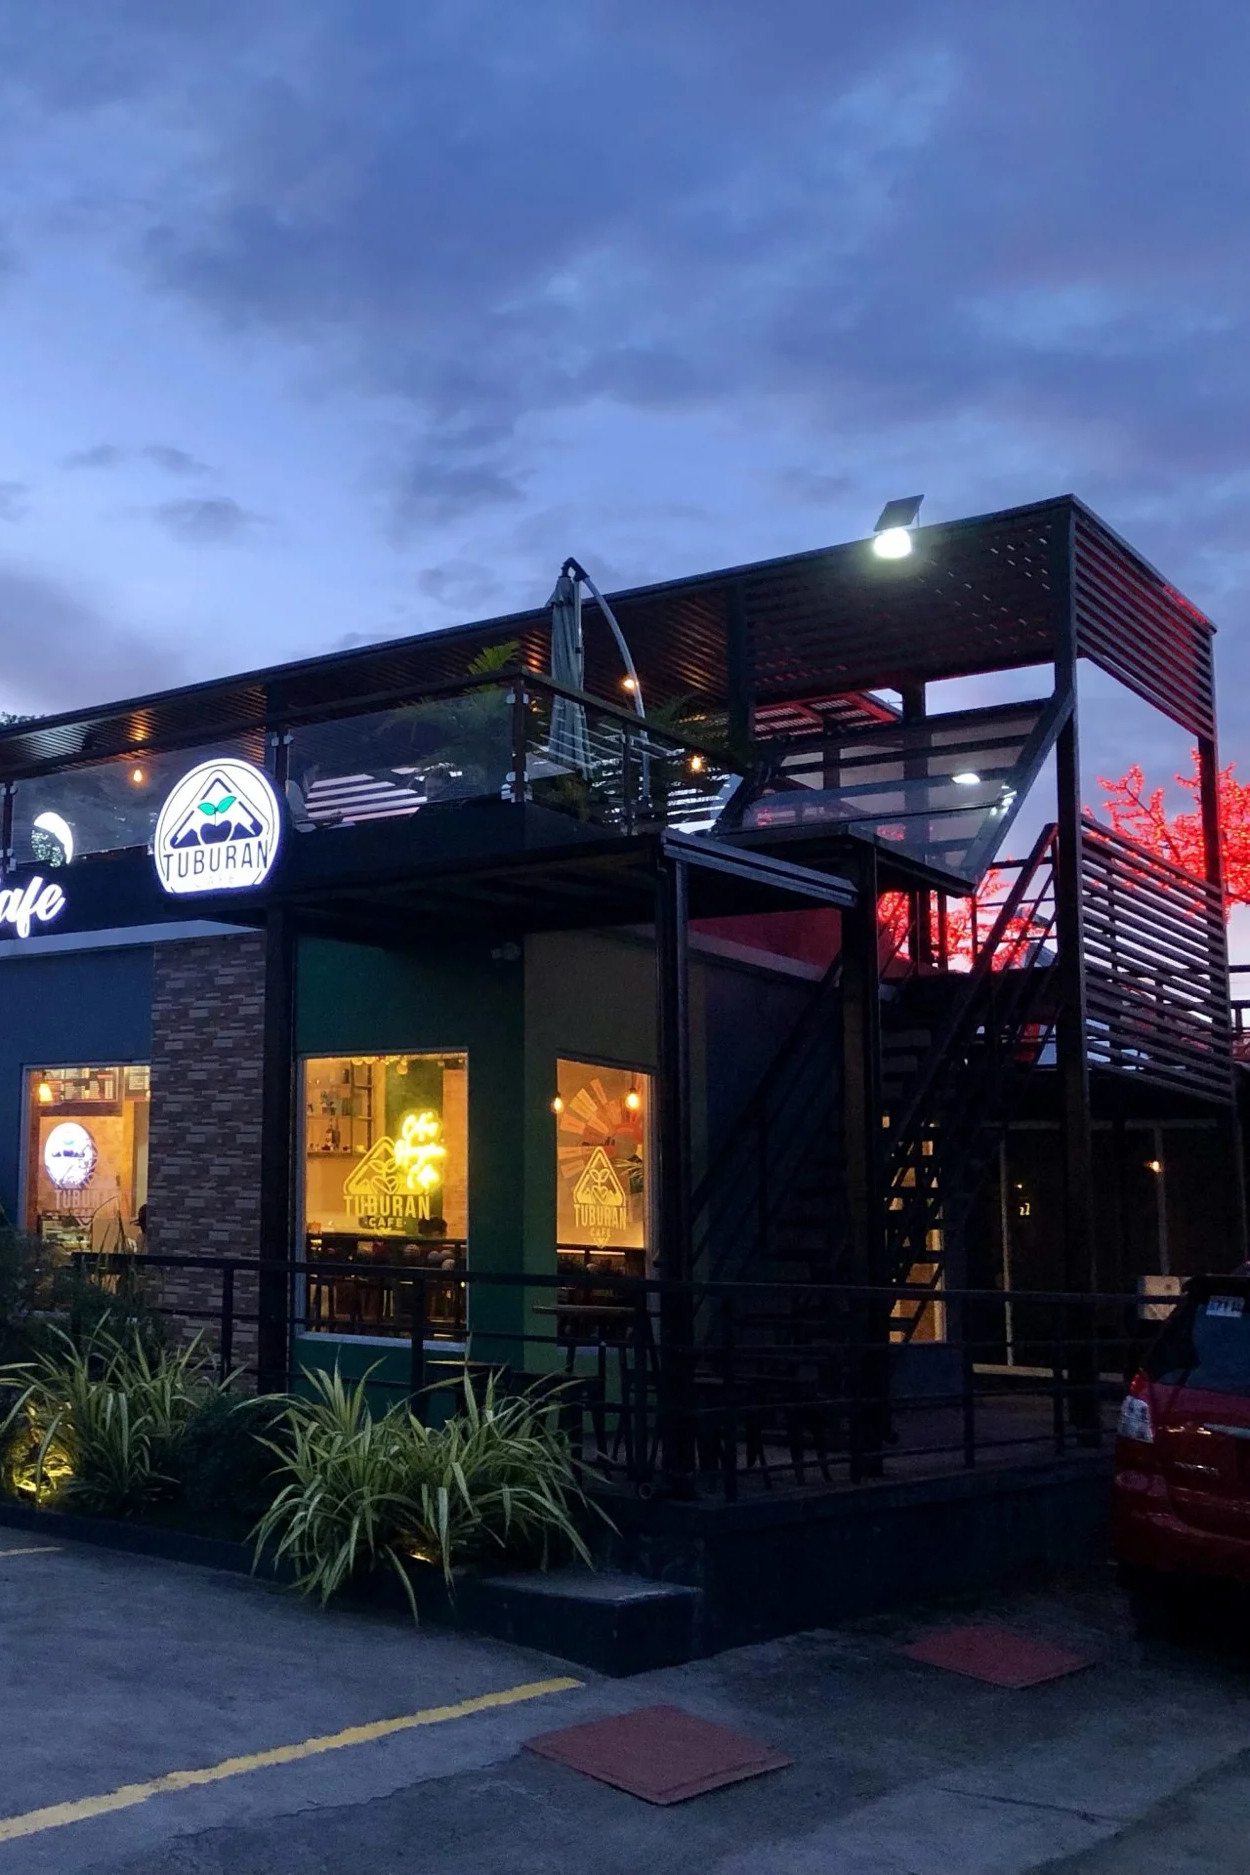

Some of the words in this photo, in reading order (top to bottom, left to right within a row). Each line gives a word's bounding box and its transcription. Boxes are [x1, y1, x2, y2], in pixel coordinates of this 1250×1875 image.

[163, 838, 269, 882] TUBURAN
[54, 1189, 117, 1210] TUBUR
[343, 1195, 430, 1221] TUBURAN
[368, 1217, 403, 1228] CAFE
[573, 1203, 627, 1231] TUBURAN
